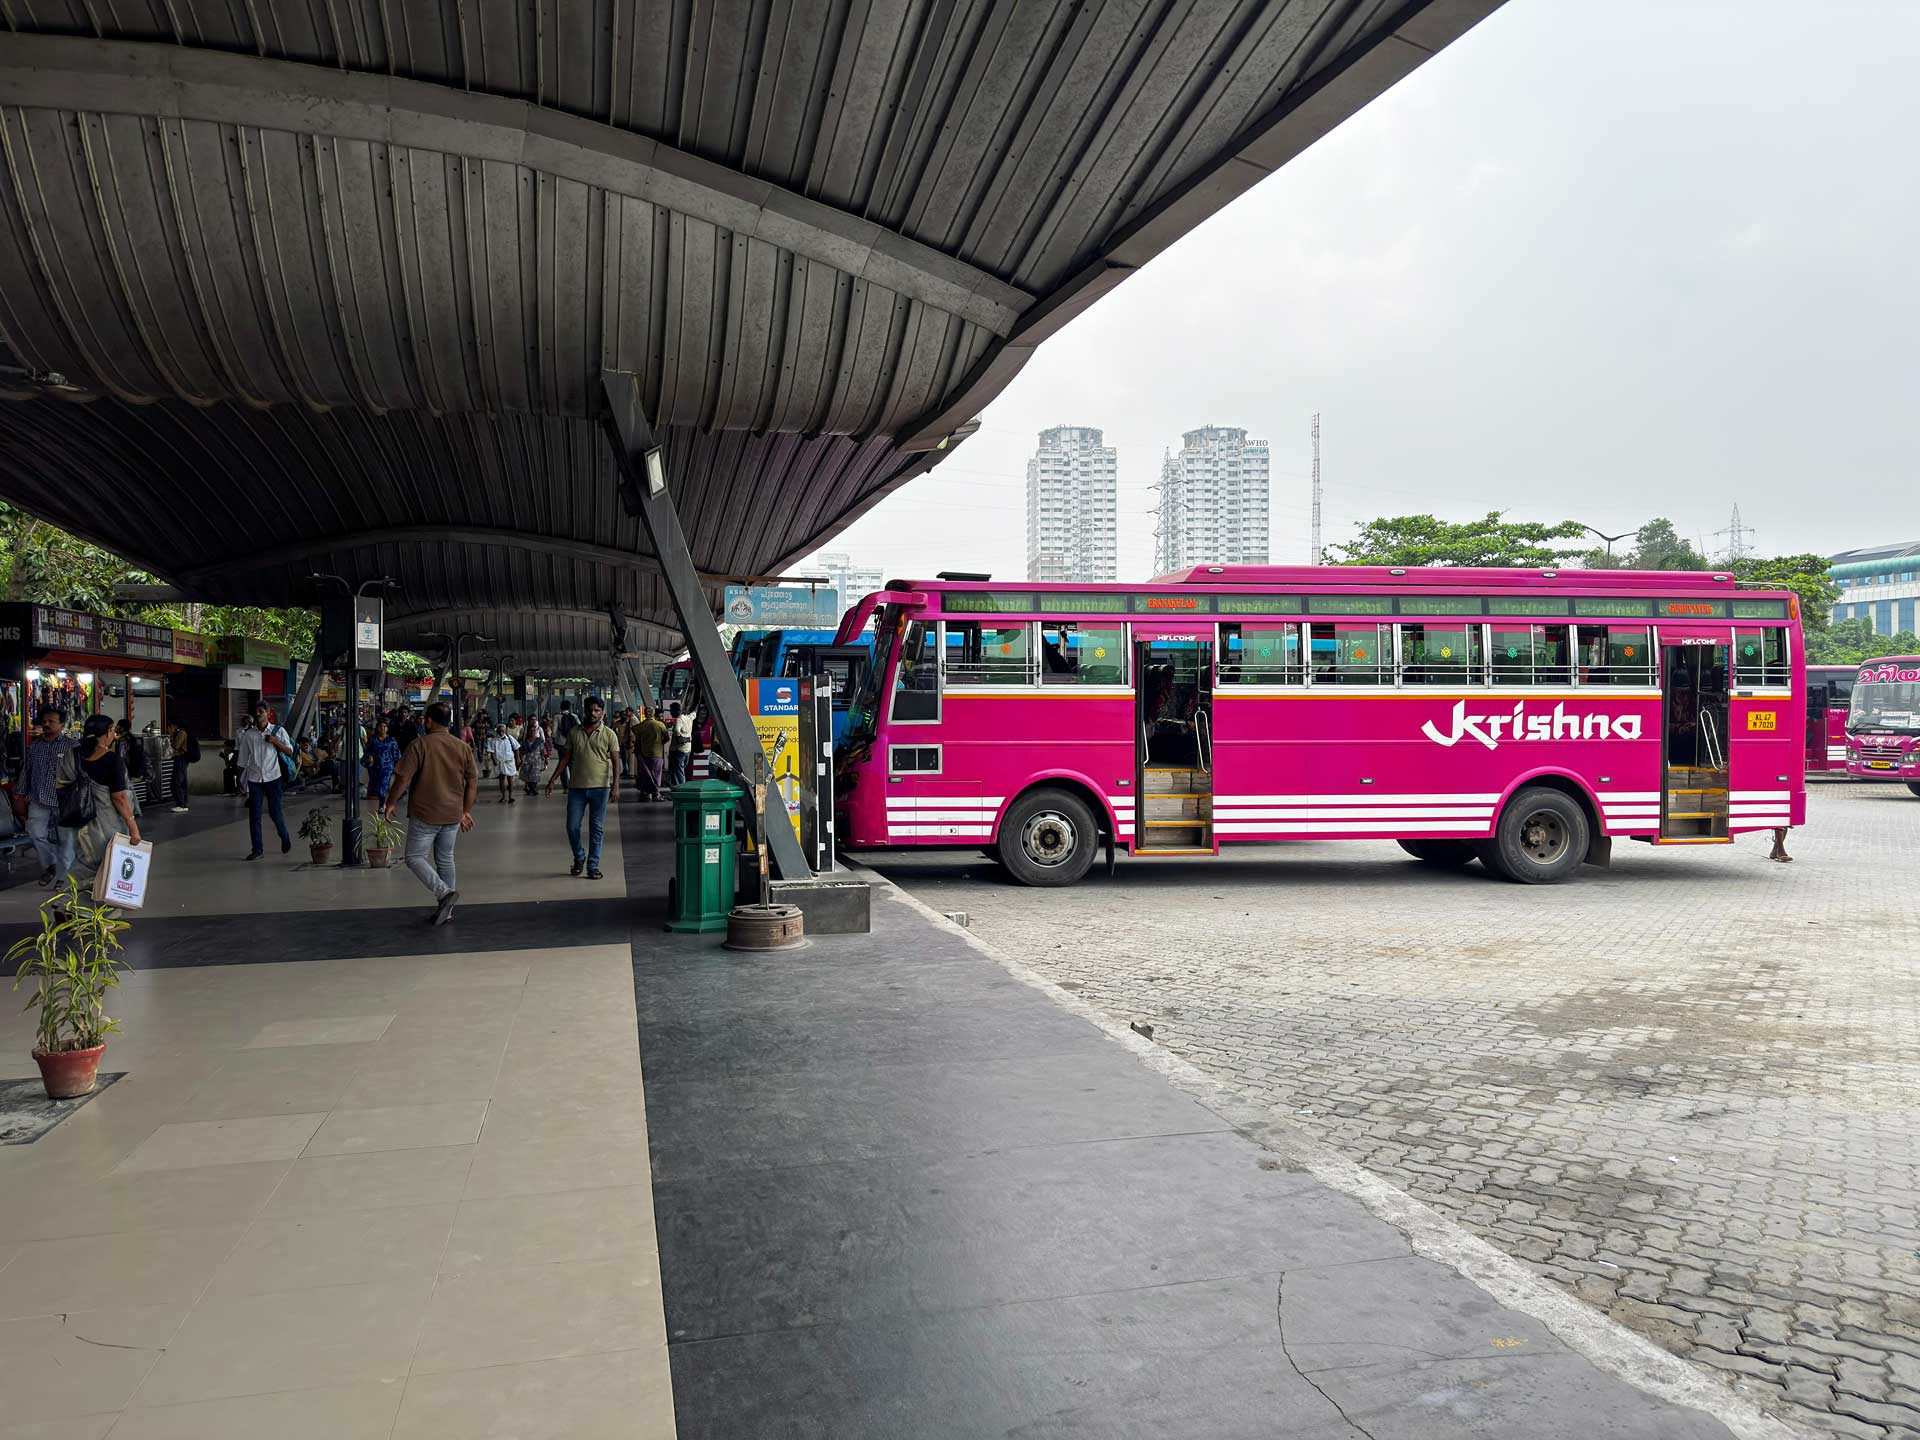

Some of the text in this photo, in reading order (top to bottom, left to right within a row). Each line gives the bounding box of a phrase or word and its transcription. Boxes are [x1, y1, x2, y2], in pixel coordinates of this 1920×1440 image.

[1244, 439, 1268, 447] AWHO
[38, 608, 48, 623] TEA
[0, 626, 21, 641] KS
